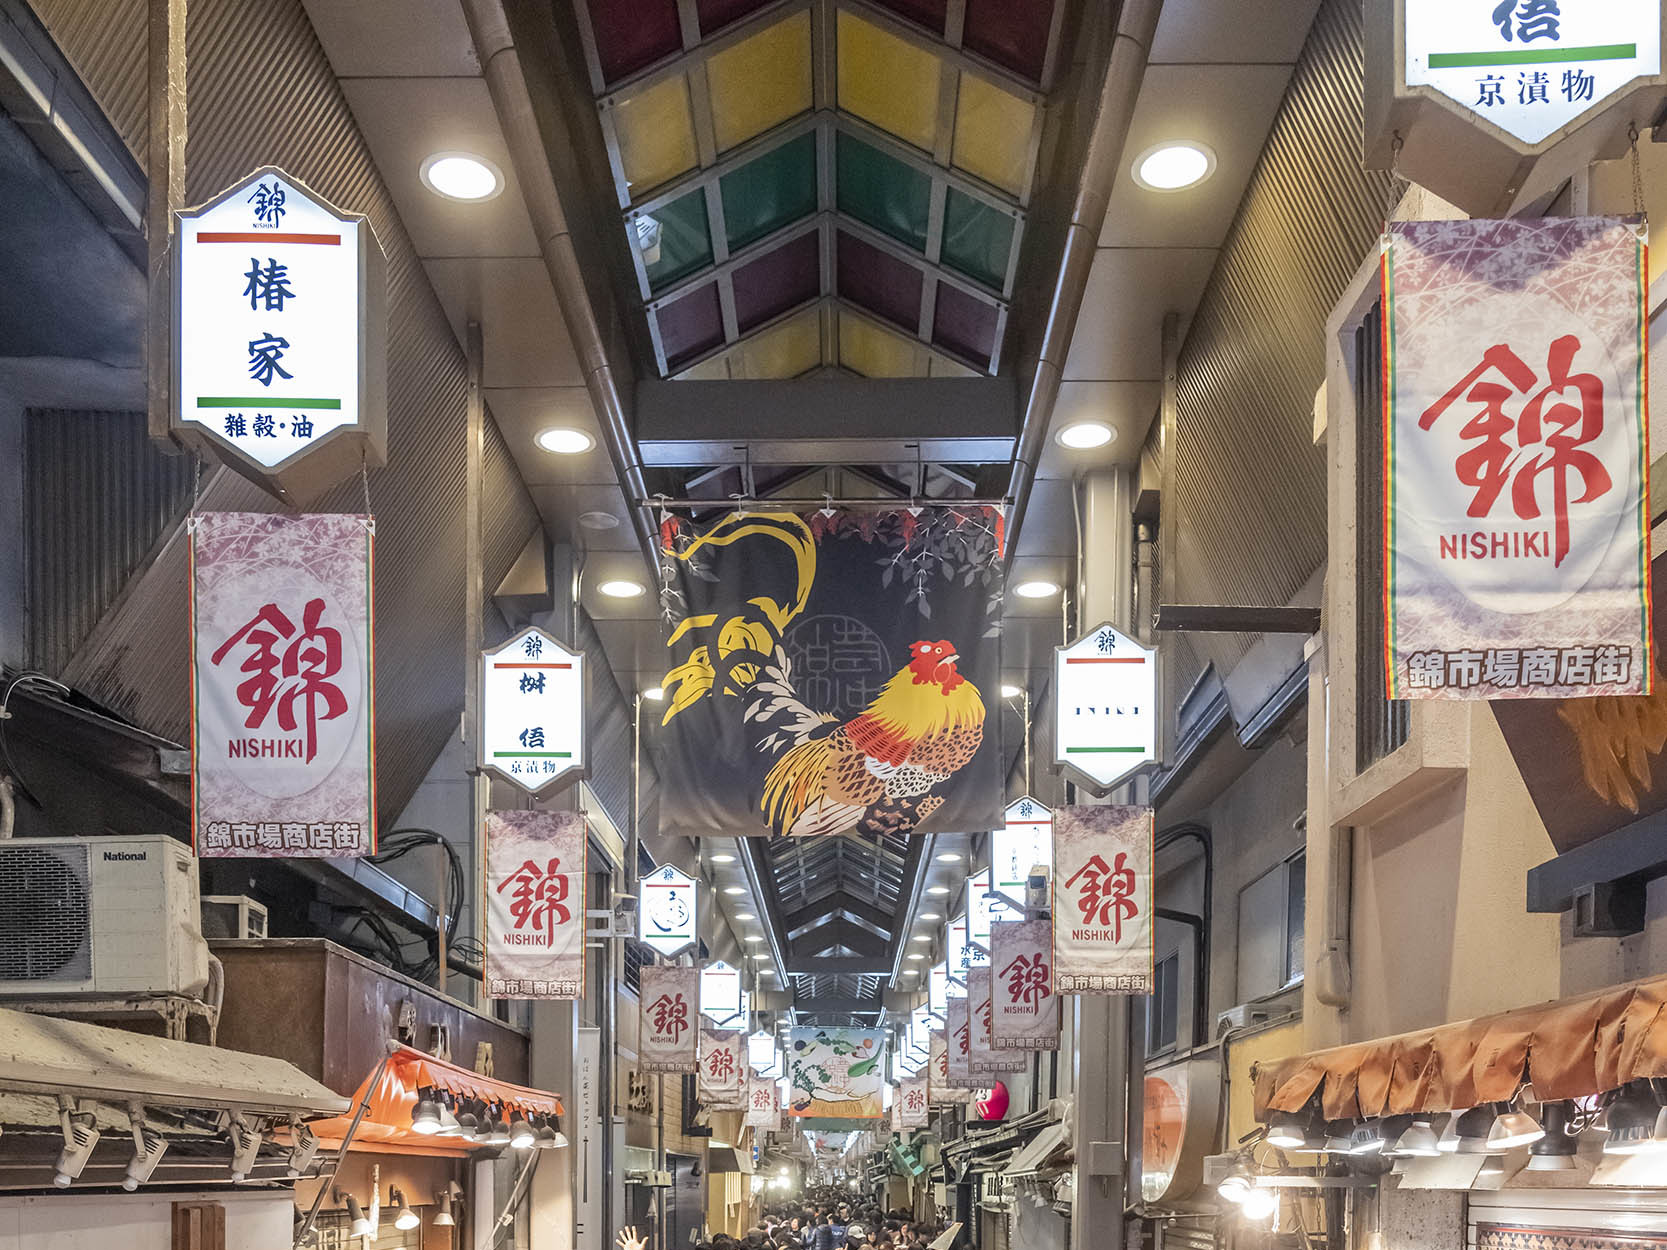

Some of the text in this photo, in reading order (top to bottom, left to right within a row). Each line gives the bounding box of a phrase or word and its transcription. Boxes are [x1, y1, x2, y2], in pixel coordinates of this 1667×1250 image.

[1474, 69, 1595, 107] 京漬物
[248, 182, 286, 228] 錦
[243, 258, 296, 387] 椿家
[224, 413, 314, 439] 雑穀・油
[1418, 335, 1612, 568] 錦
[1440, 531, 1549, 559] NISHIKI
[521, 636, 542, 661] 錦
[1094, 630, 1116, 655] 錦
[211, 598, 348, 764] 錦
[1408, 646, 1632, 690] 錦市場商店街
[228, 738, 303, 758] NISHIKI
[206, 822, 361, 849] 錦市場商店街
[103, 852, 147, 861] National
[496, 857, 571, 949] 錦
[1065, 852, 1138, 944] 錦
[504, 934, 546, 946] NISHIKI
[1072, 929, 1114, 942] NISHIKI
[491, 980, 577, 995] 錦市場商店街
[999, 952, 1051, 1016] 錦
[1059, 975, 1145, 990] 錦市場商店街
[646, 992, 689, 1045] 錦
[1003, 1006, 1034, 1014] NISHIKI
[704, 1047, 735, 1084] 錦
[750, 1088, 771, 1112] 錦
[904, 1089, 925, 1114] 錦
